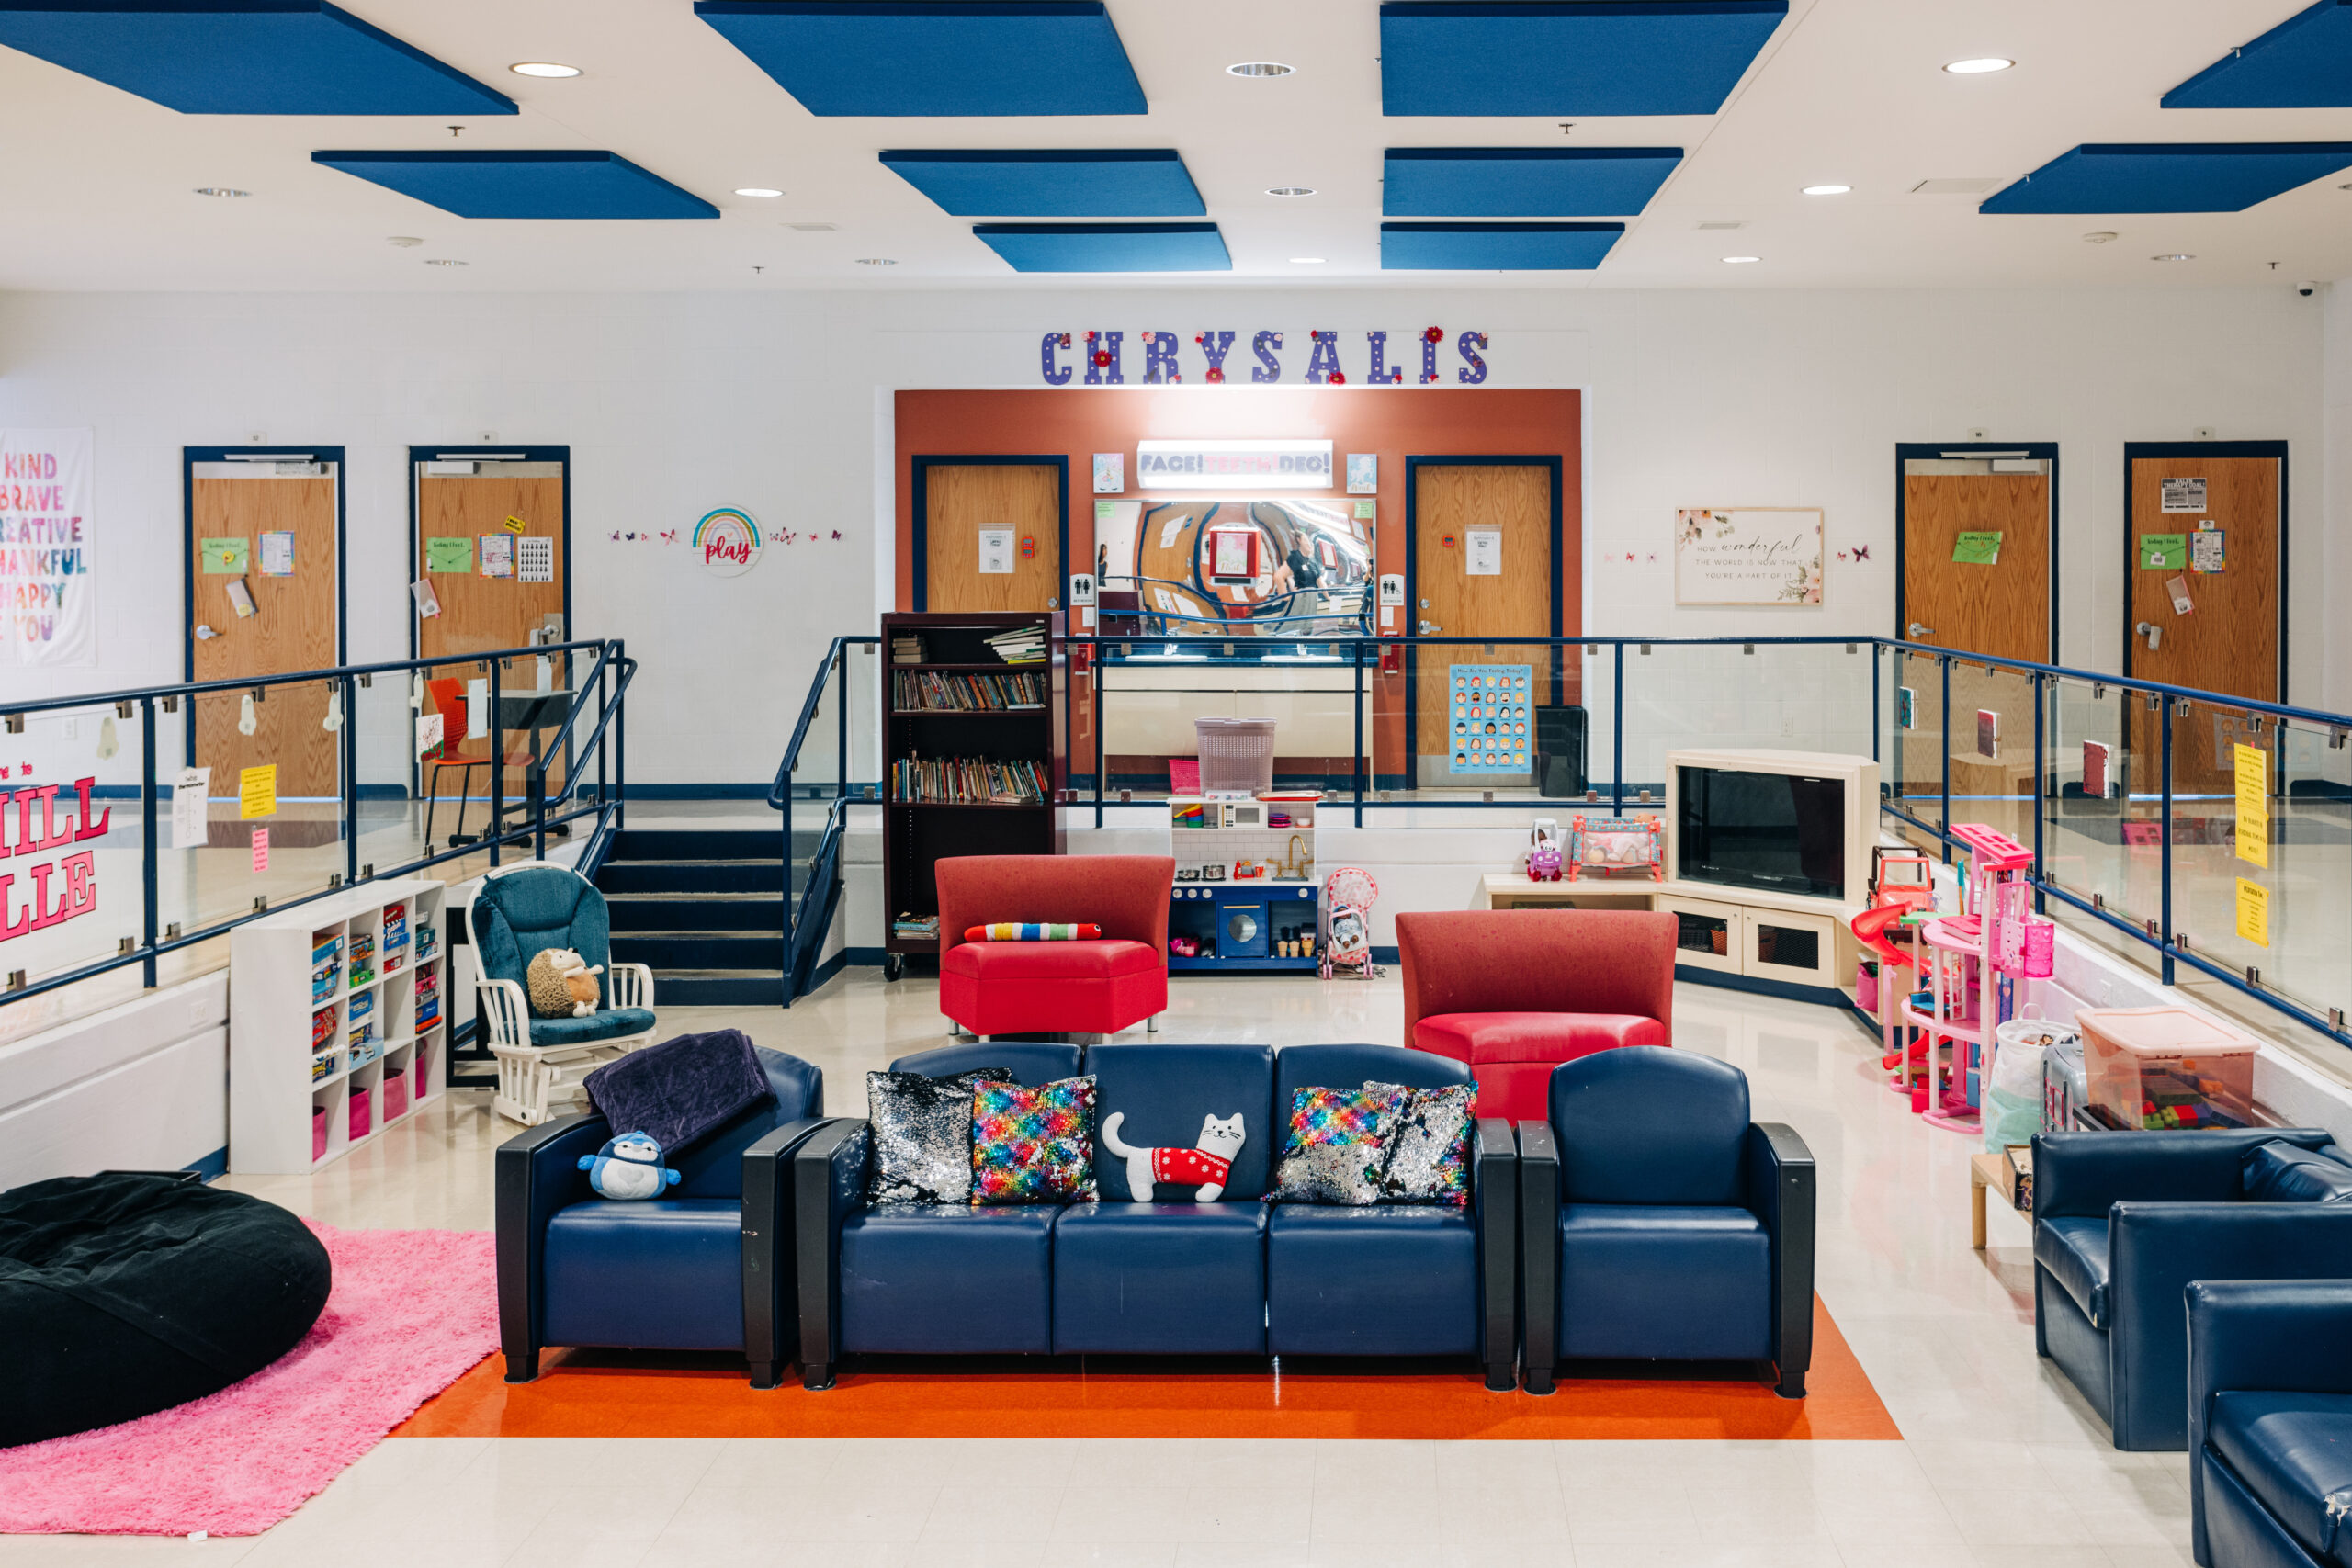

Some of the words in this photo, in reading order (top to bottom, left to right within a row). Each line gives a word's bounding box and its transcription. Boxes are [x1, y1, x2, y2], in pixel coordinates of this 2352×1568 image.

[1041, 331, 1487, 386] CHRYSALIS
[5, 452, 57, 479] KIND
[1140, 454, 1204, 474] FACE!
[1204, 453, 1280, 474] TEETH!
[1279, 453, 1330, 474] DEO!
[0, 485, 64, 511] BRAVE
[706, 536, 752, 565] play
[1721, 534, 1803, 561] wonderful
[0, 582, 66, 610] HAPPY
[14, 615, 53, 642] YOU
[21, 761, 33, 776] to
[178, 781, 205, 791] thermometer
